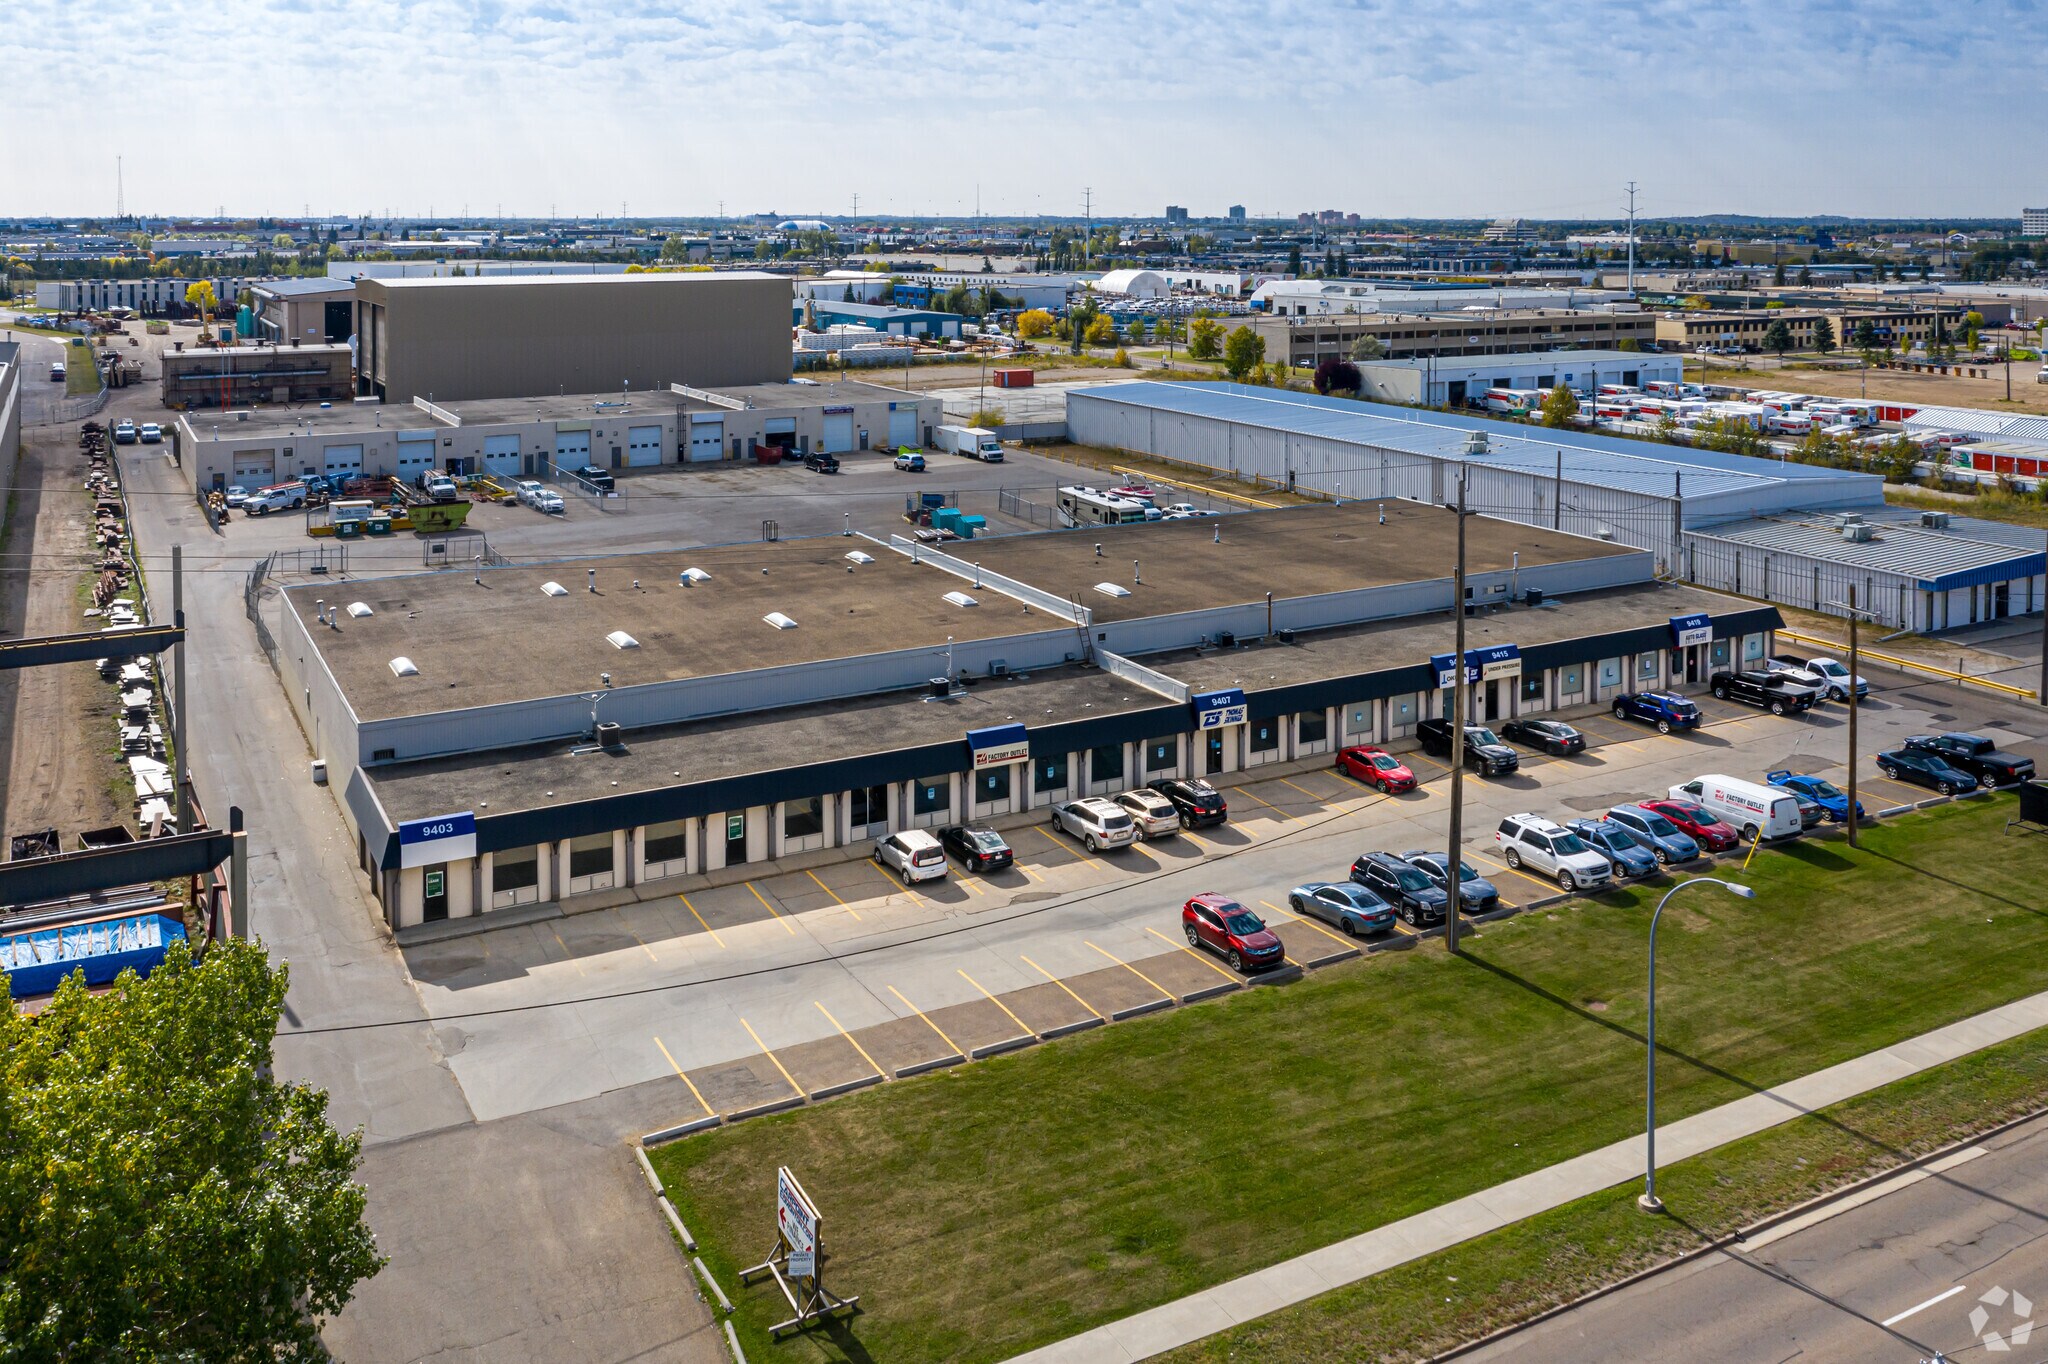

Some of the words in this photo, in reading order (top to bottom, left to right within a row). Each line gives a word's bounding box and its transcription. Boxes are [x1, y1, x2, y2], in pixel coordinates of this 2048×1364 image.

[1491, 650, 1509, 659] 9415
[1211, 696, 1231, 706] 9407
[988, 751, 1009, 760] FACTORY
[1009, 748, 1028, 757] OUTLET
[1726, 793, 1746, 805] FACTORY
[1746, 800, 1765, 810] OUTLET
[422, 822, 454, 837] 9403
